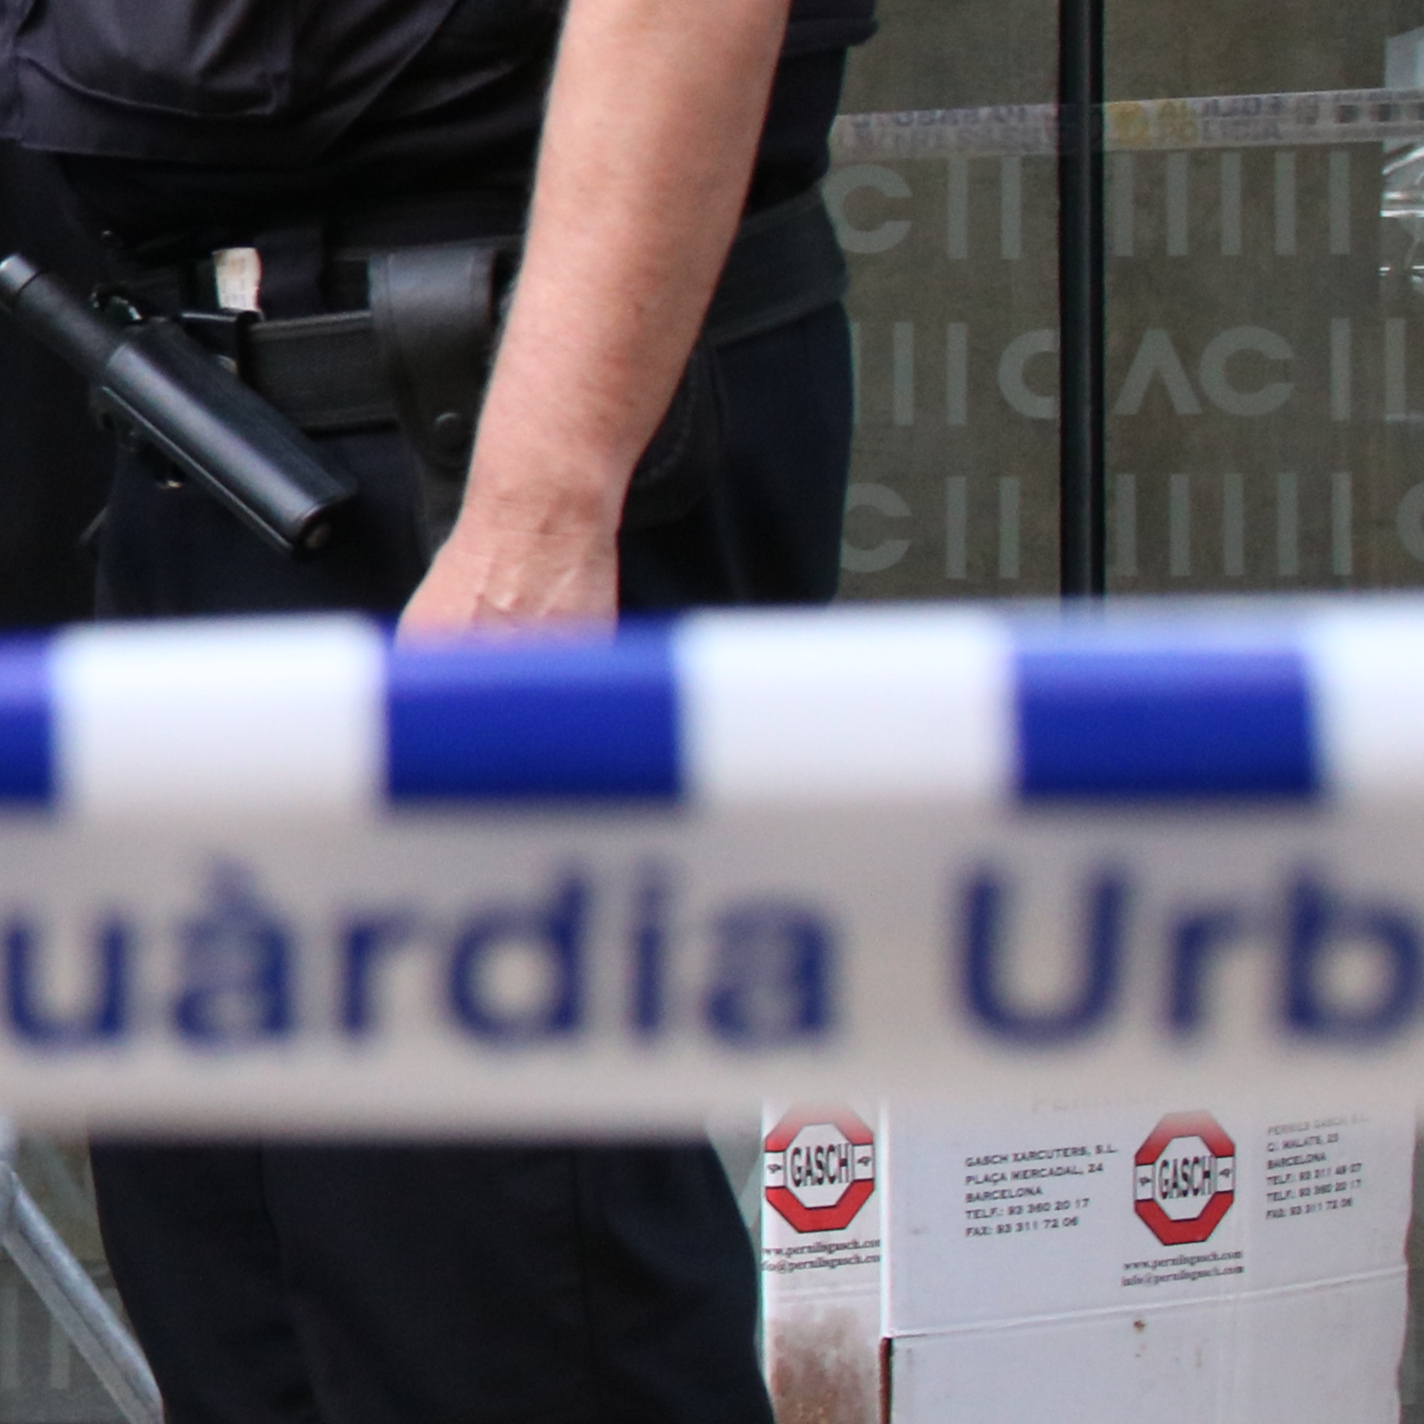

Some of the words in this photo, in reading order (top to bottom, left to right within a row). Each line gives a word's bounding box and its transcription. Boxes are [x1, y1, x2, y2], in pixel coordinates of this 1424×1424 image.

[789, 1143, 853, 1188] GASCH
[964, 1156, 1008, 1167] GASCH
[1266, 1152, 1327, 1170] BARCELONA
[964, 1173, 1008, 1186] PLAÇA
[1088, 1163, 1104, 1174] 24
[1158, 1155, 1214, 1200] GASCH
[965, 1186, 1043, 1203] BARCELONA
[1008, 1206, 1024, 1216] 93
[1026, 1202, 1052, 1214] 360
[1054, 1200, 1071, 1211] 20
[1075, 1198, 1090, 1209] 17
[965, 1226, 994, 1238] FAX:
[996, 1224, 1012, 1234] 93
[1015, 1222, 1040, 1233] 311
[1042, 1219, 1060, 1230] 72
